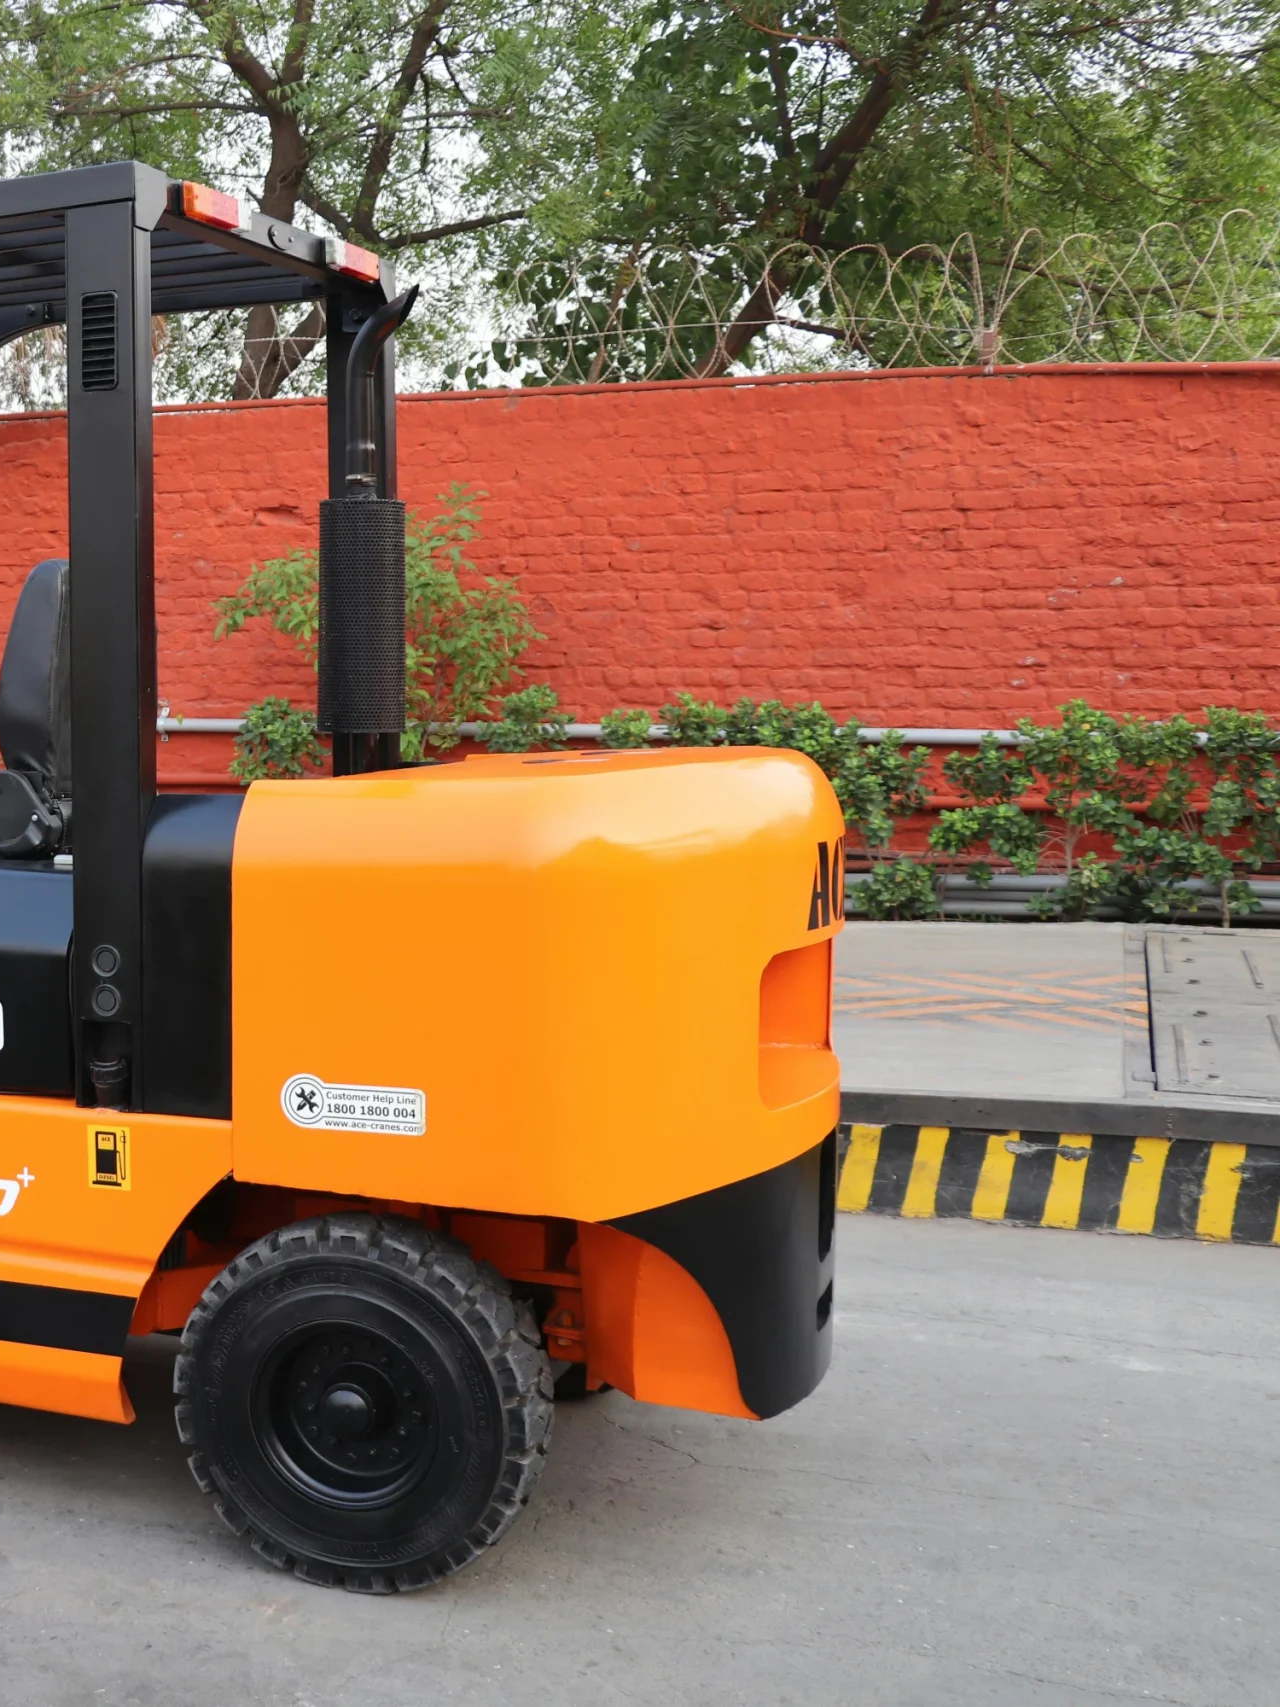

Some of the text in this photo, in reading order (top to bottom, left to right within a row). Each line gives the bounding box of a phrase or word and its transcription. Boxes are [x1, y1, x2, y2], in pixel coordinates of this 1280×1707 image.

[326, 1091, 417, 1105] Customer Help Line
[327, 1103, 417, 1119] 1800 1800 004
[325, 1119, 423, 1133] www.ace-cranes.com
